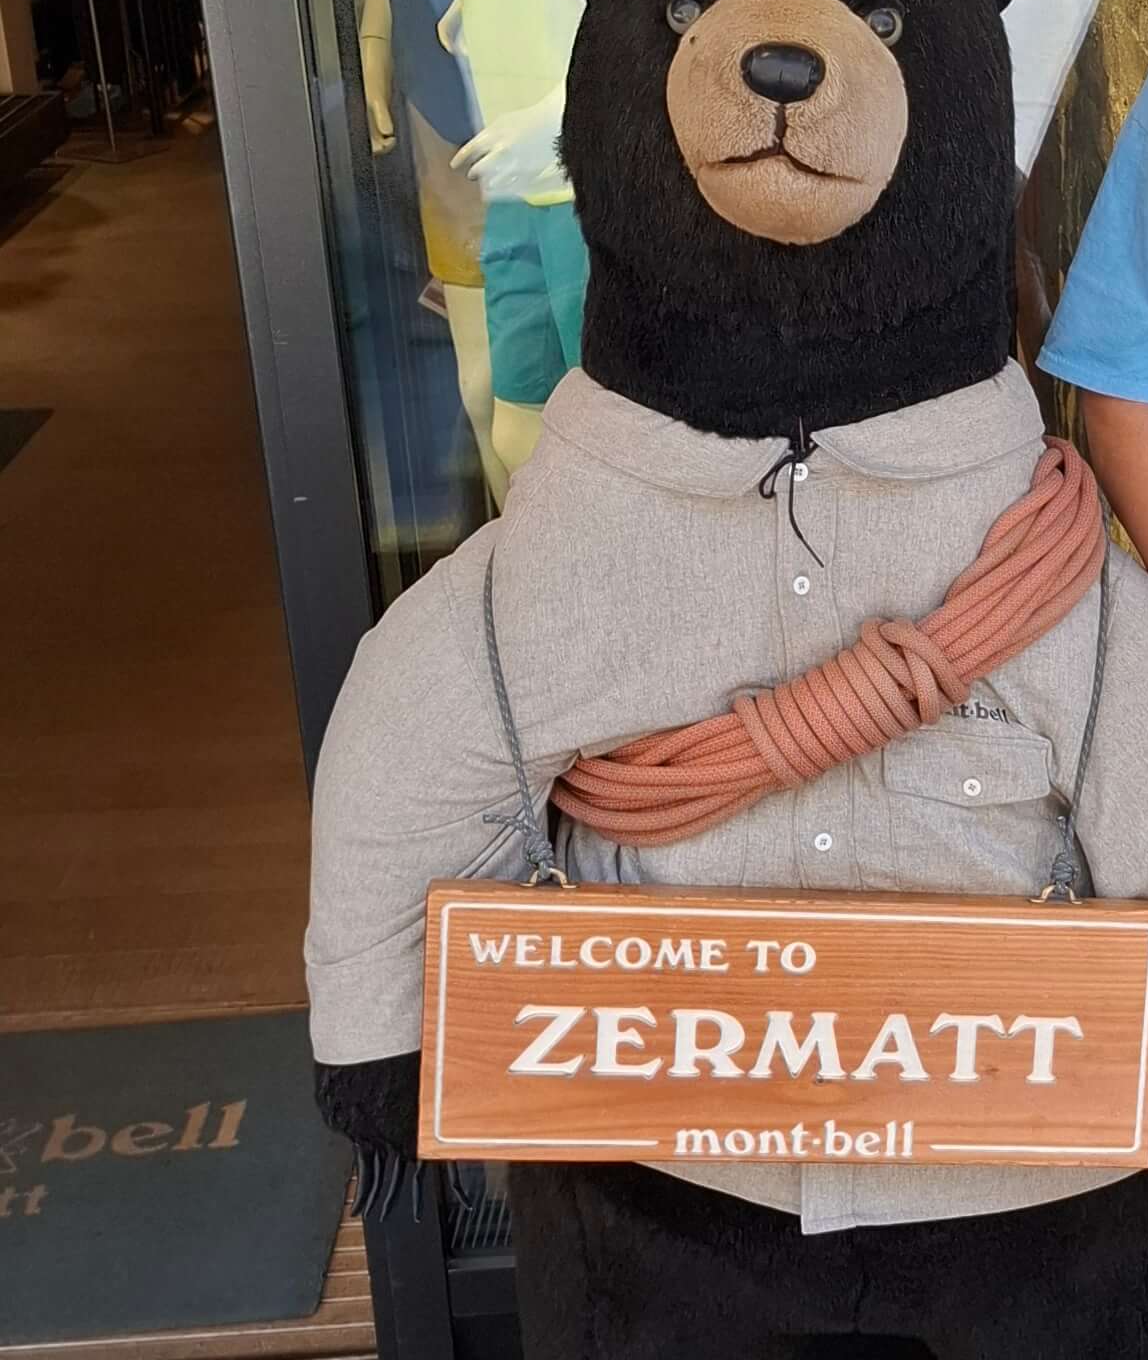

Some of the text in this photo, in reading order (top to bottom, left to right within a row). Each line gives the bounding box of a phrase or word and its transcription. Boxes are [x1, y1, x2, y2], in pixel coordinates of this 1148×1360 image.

[468, 932, 818, 974] WELCOME TO
[508, 1003, 1084, 1084] ZERMATT
